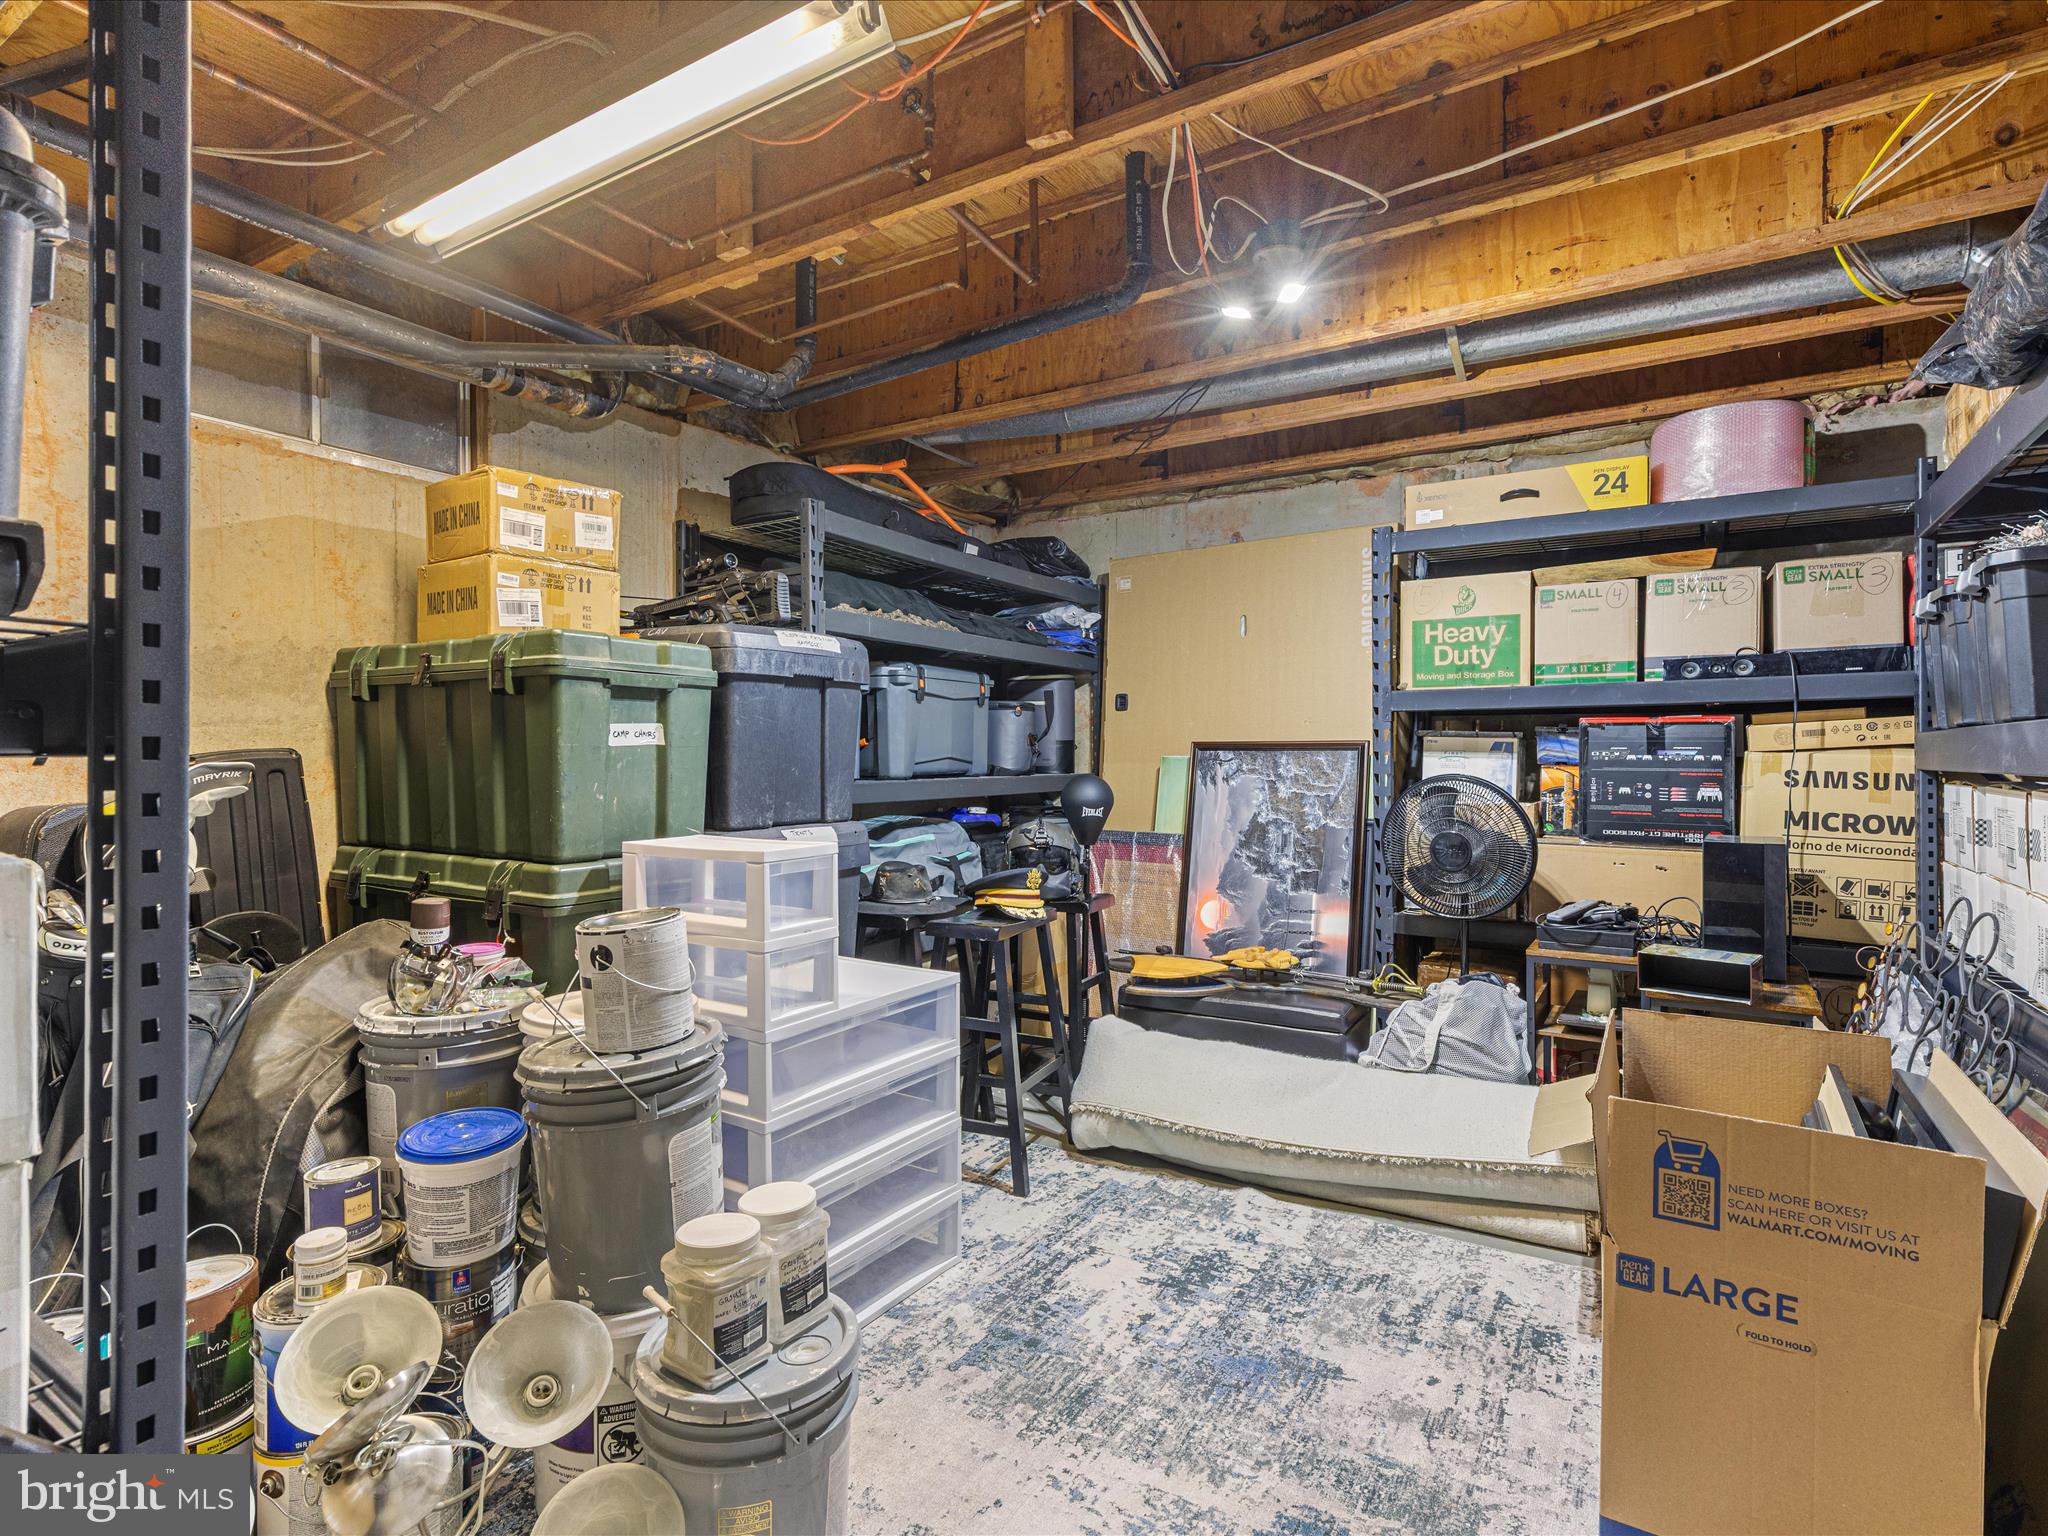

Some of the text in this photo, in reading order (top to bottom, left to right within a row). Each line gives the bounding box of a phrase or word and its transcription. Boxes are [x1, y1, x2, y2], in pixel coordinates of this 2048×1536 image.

[1606, 464, 1630, 472] DISPLAY
[1593, 470, 1629, 497] 24
[434, 507, 449, 535] MADE
[450, 506, 458, 532] IN
[458, 501, 480, 529] CHINA
[1829, 560, 1866, 569] STRENGTH
[1808, 568, 1865, 582] SMALL
[1871, 565, 1888, 588] 3
[1556, 587, 1603, 601] SMALL
[1612, 587, 1622, 601] 4
[1676, 582, 1727, 595] SMALL
[1729, 580, 1749, 601] 3
[427, 589, 445, 616] MADE
[446, 588, 454, 614] IN
[455, 585, 478, 612] CHINA
[1425, 622, 1508, 646] Heavy
[1434, 644, 1497, 668] Duty
[1416, 669, 1515, 682] Moving and Storage Box
[1556, 663, 1569, 673] 17"
[1579, 663, 1592, 673] 11"
[1593, 664, 1600, 672] x
[1601, 662, 1616, 672] 13"
[612, 730, 656, 740] CAMP CHAIRS
[192, 770, 243, 785] MAVRIK
[1783, 769, 1916, 792] SAMSUN
[1783, 810, 1917, 837] MICROW
[1661, 831, 1704, 839] RAPTURE
[1825, 841, 1842, 853] de
[1845, 842, 1917, 858] Microonda
[1728, 1183, 1868, 1220] NEED MORE BOXES?
[1728, 1198, 1920, 1246] SCAN HERE OR VISIT US AT
[1728, 1212, 1920, 1262] WALMART.COM/MOVING
[1620, 1259, 1650, 1275] pen+
[1623, 1268, 1649, 1286] GEAR
[1663, 1266, 1799, 1325] LARGE
[437, 1293, 493, 1316] uratio
[1745, 1330, 1812, 1353] FOLD TO HOLD
[603, 1411, 635, 1423] ADVERTEN
[728, 1503, 769, 1517] WARNING
[736, 1515, 761, 1526] AVISO
